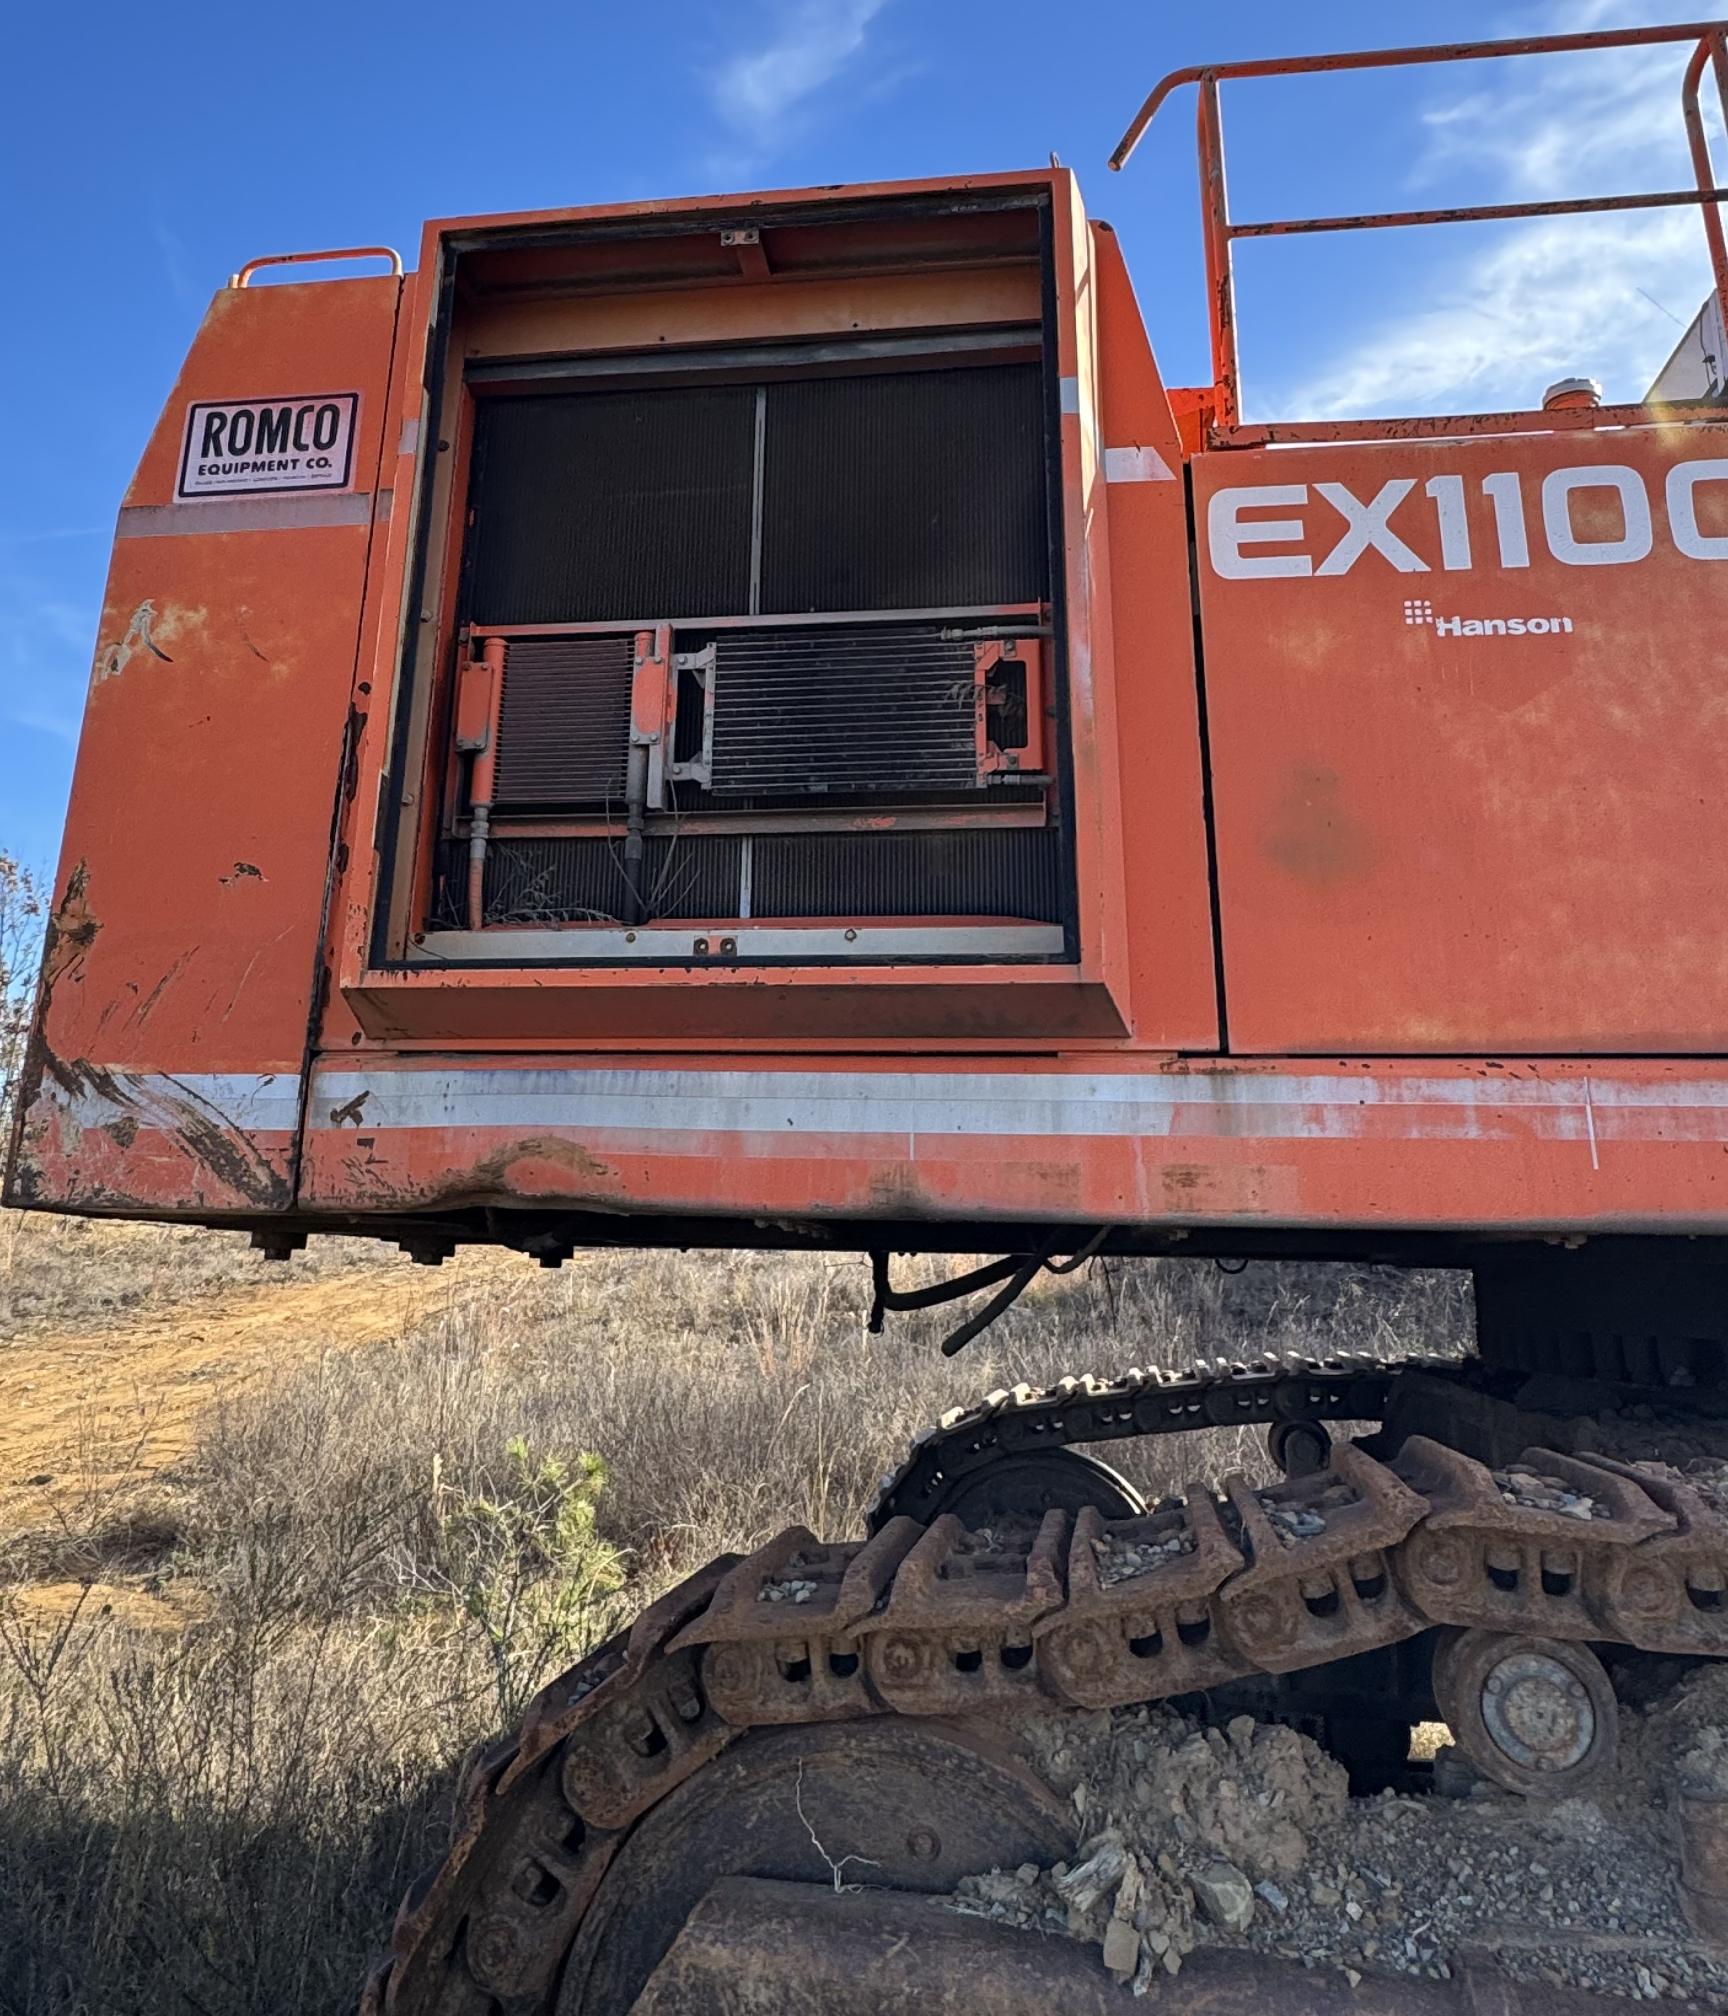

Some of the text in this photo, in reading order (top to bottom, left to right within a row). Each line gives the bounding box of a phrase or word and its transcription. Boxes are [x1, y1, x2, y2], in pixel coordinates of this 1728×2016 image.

[201, 404, 340, 458] ROMCO
[198, 457, 332, 475] EQUIPMENT CO.
[1435, 616, 1573, 637] Hanson
